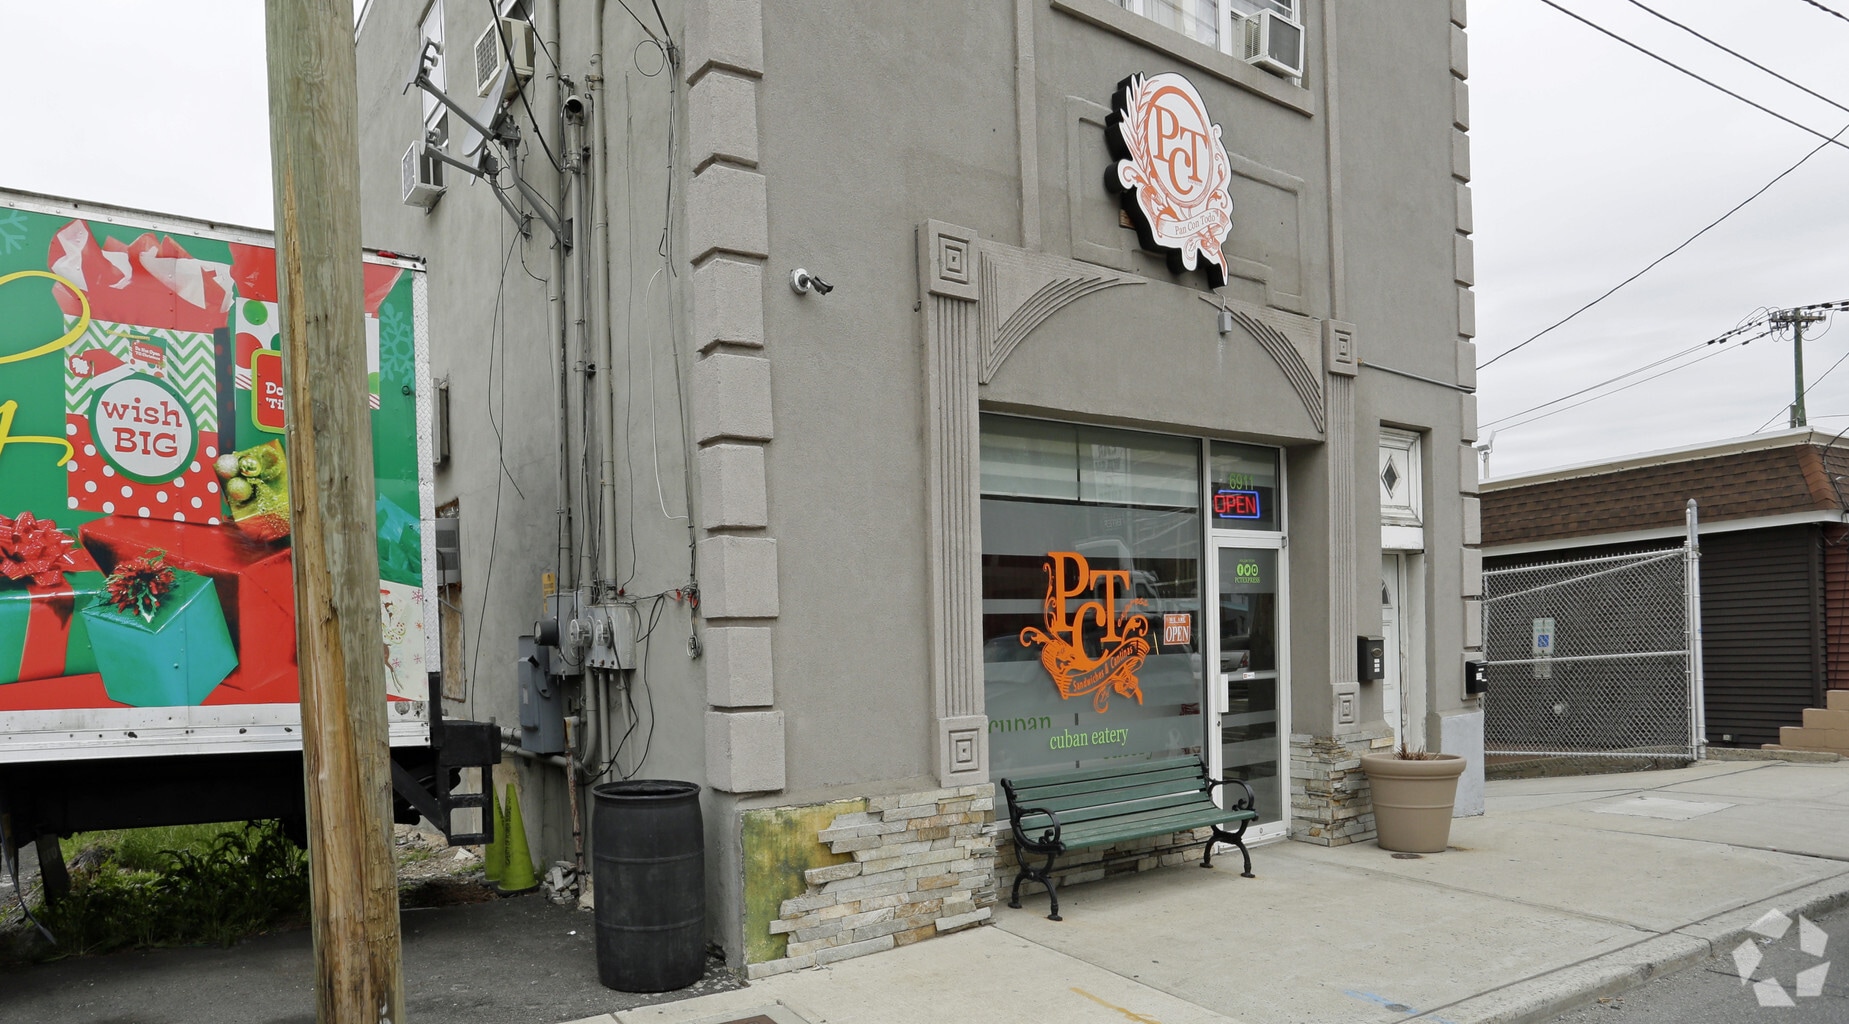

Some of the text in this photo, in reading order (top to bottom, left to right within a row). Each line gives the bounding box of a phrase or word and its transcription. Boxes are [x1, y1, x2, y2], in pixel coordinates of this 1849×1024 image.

[101, 397, 182, 428] wish
[112, 427, 178, 458] BIG
[1229, 473, 1255, 490] 6911
[1214, 495, 1256, 514] OPEN
[1166, 626, 1189, 642] OPEN
[1050, 727, 1129, 750] cuban eatery
